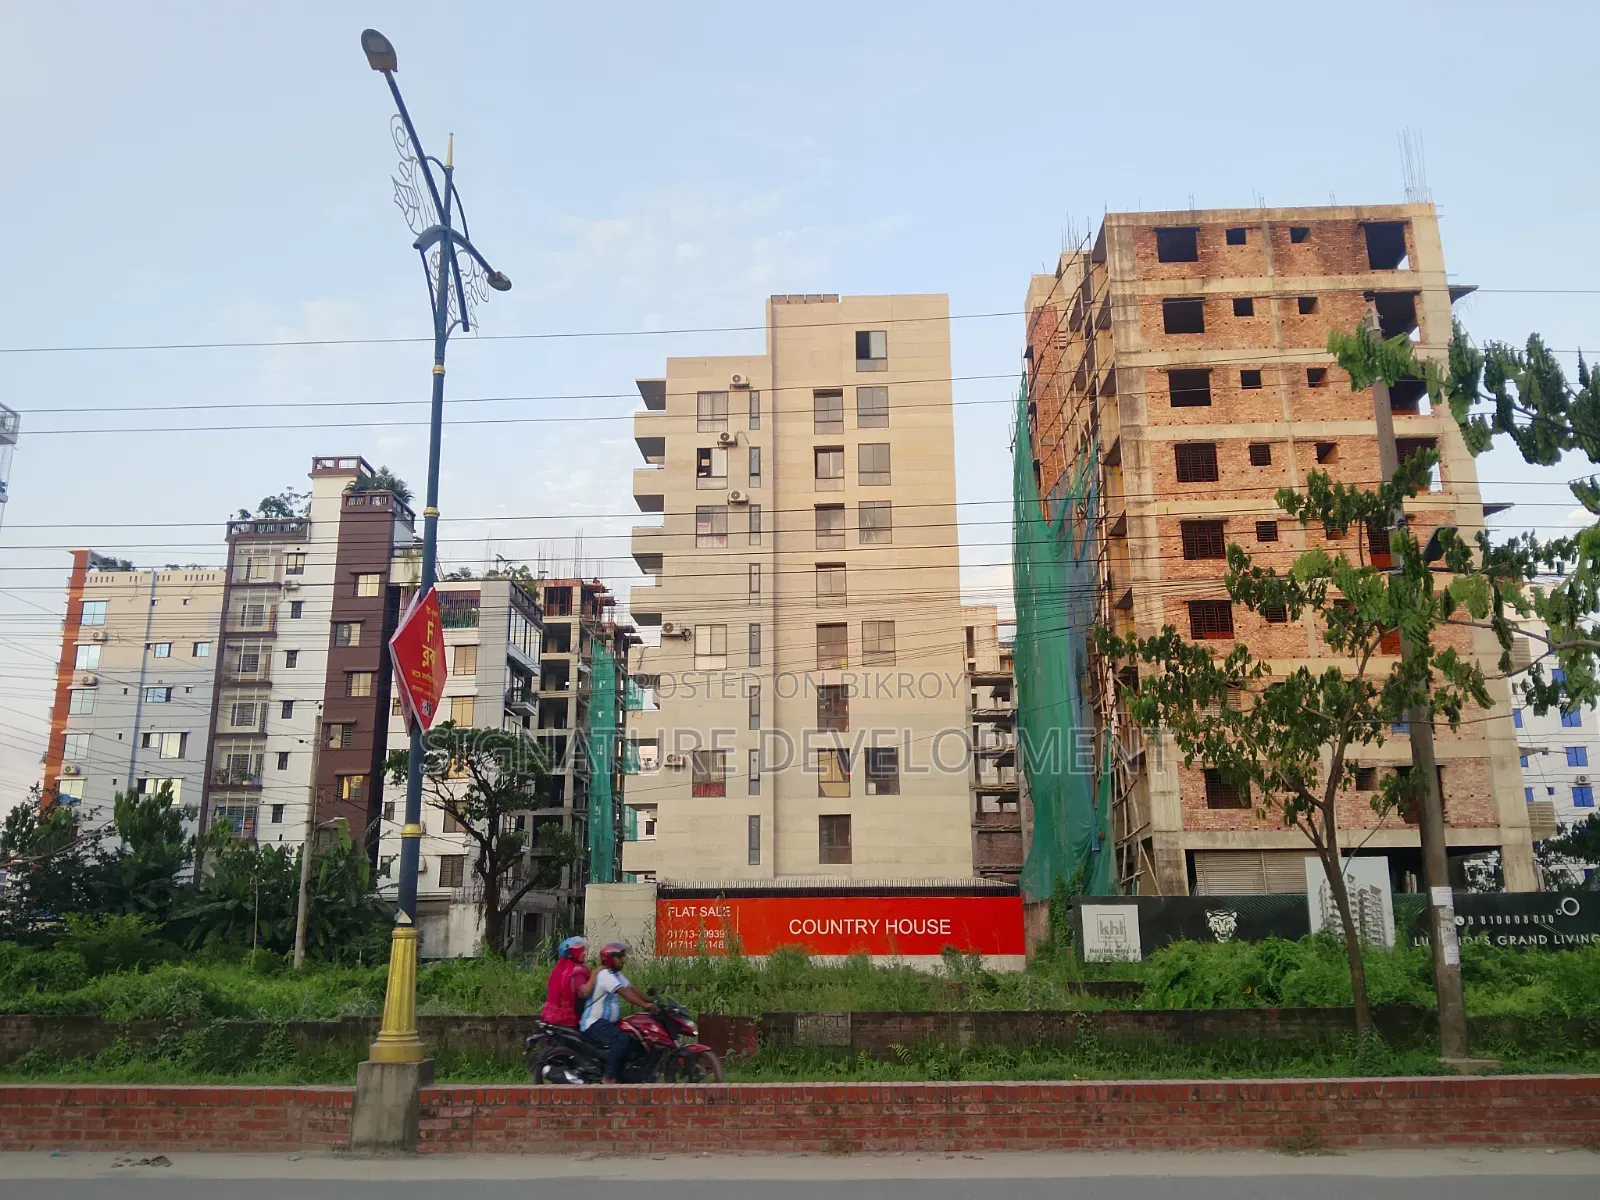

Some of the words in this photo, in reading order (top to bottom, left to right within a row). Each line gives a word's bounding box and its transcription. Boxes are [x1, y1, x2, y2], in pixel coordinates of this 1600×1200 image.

[668, 906, 697, 917] FLAT
[699, 906, 731, 917] SALE
[788, 919, 880, 935] COUNTRY
[885, 919, 952, 935] HOUSE
[1497, 934, 1548, 946] GRAND
[1554, 933, 1600, 945] LIVING
